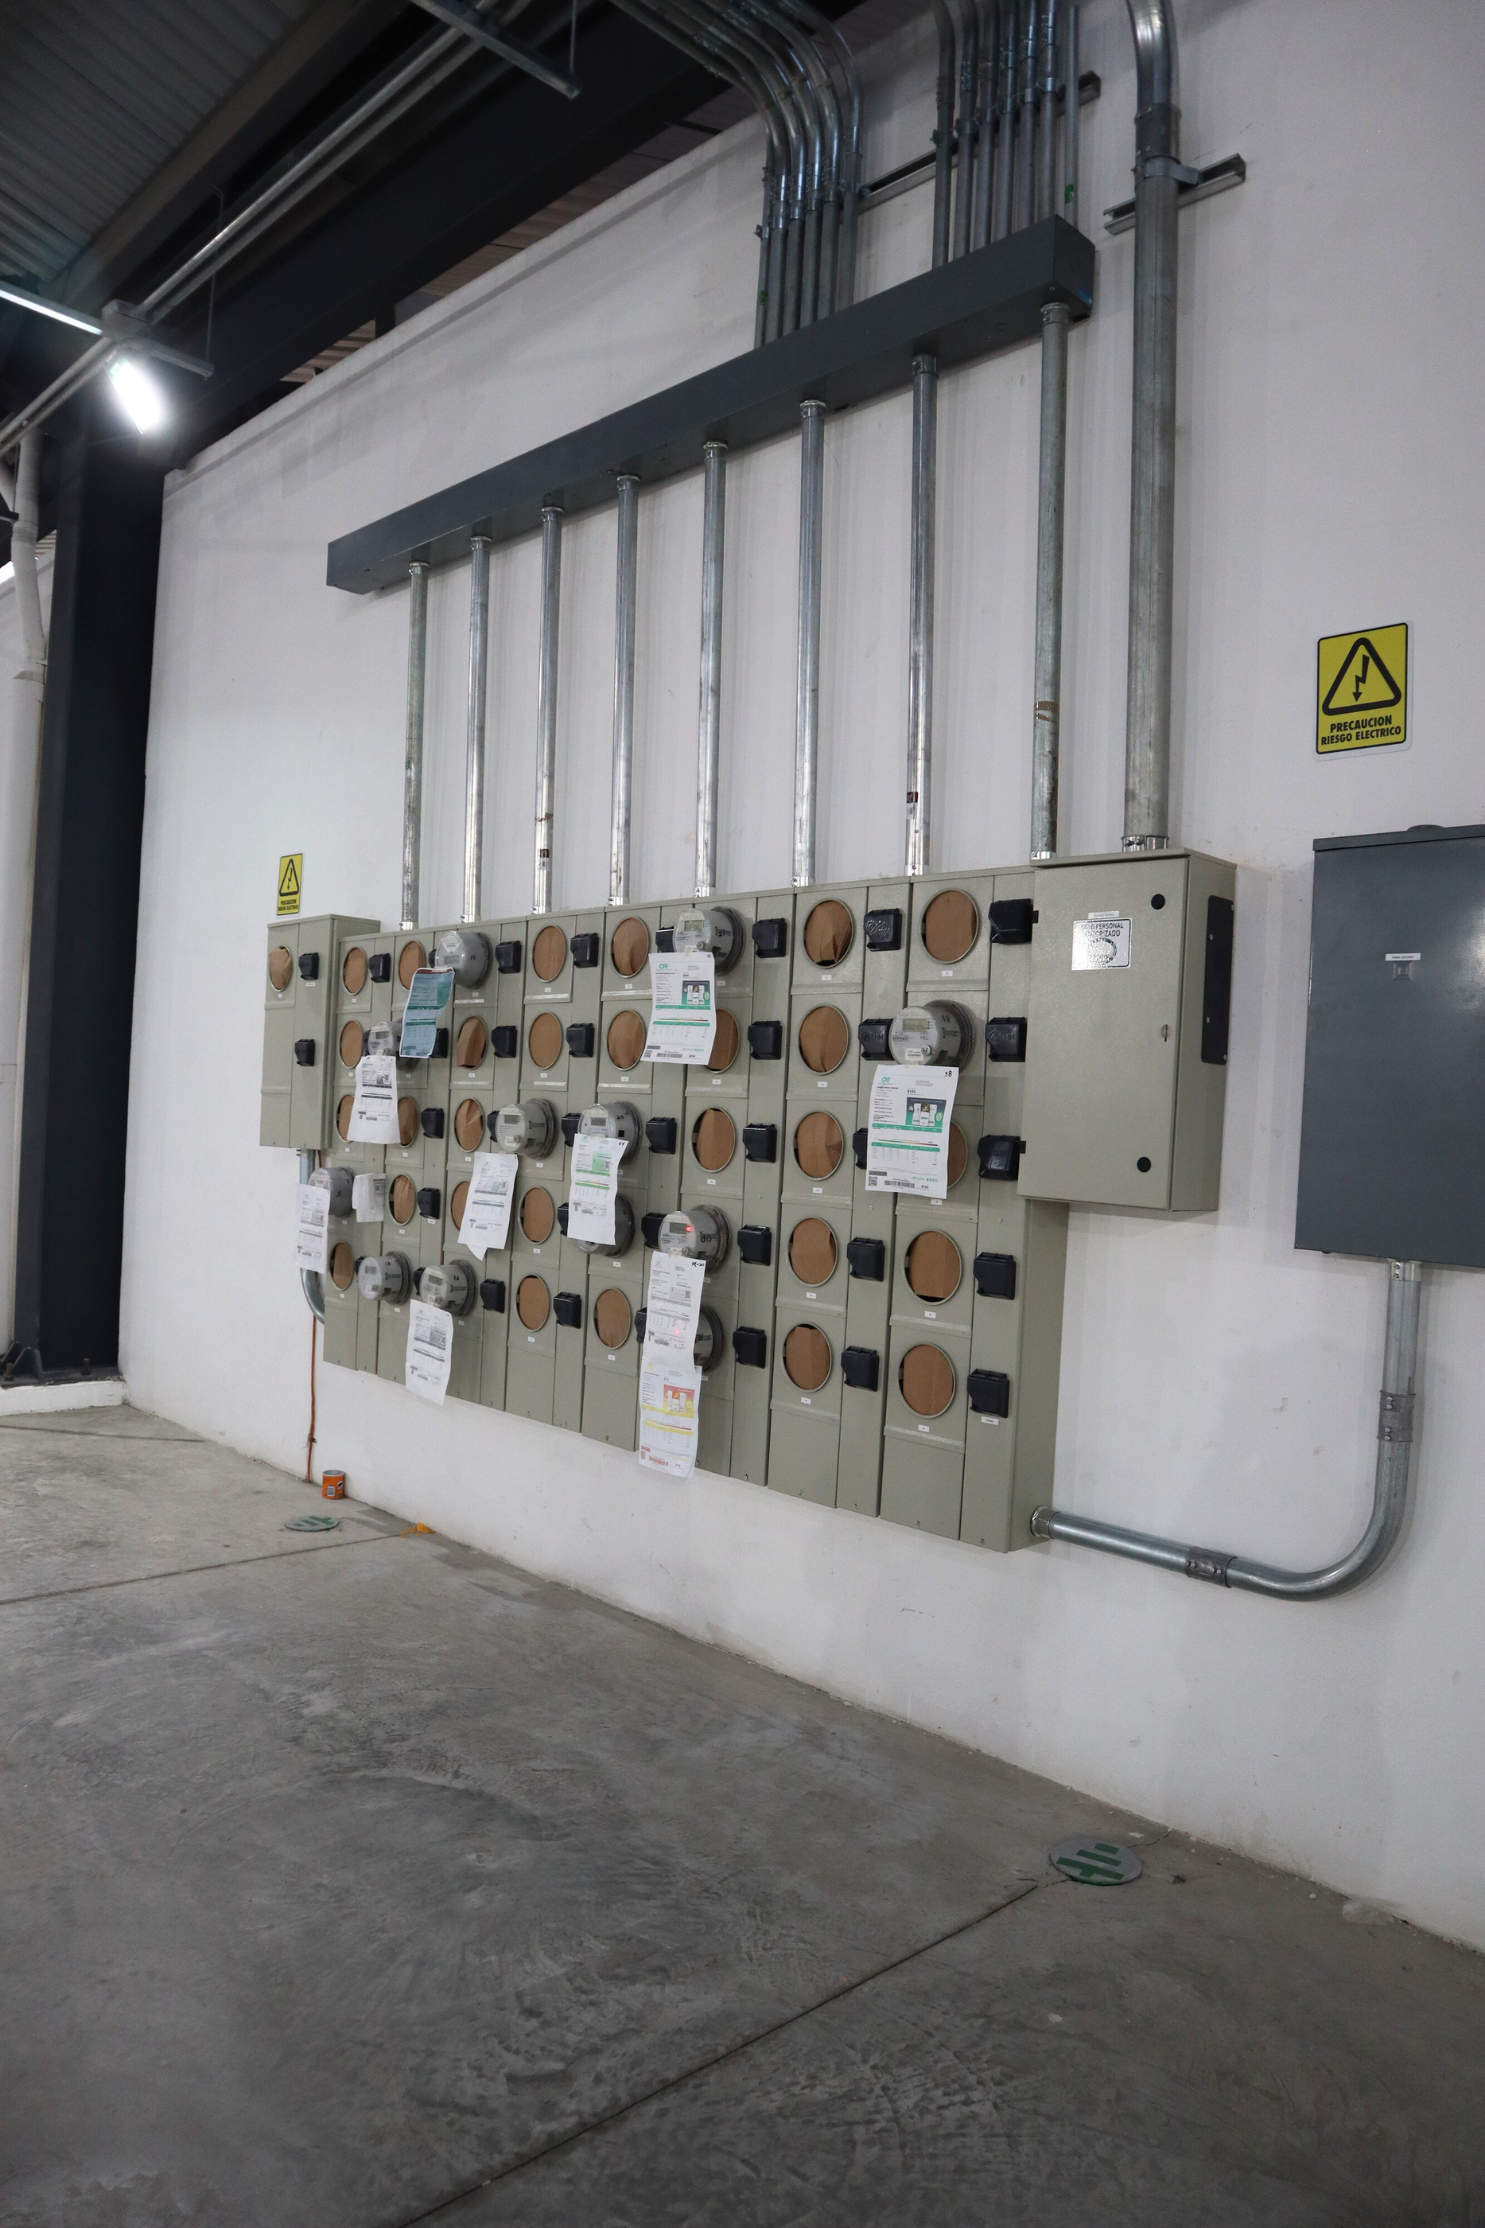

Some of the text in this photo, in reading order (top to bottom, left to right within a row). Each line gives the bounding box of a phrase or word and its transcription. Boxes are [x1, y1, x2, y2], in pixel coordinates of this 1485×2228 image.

[1330, 715, 1392, 733] PRECAUCION
[1321, 726, 1401, 745] RIESGO ELECTRICO
